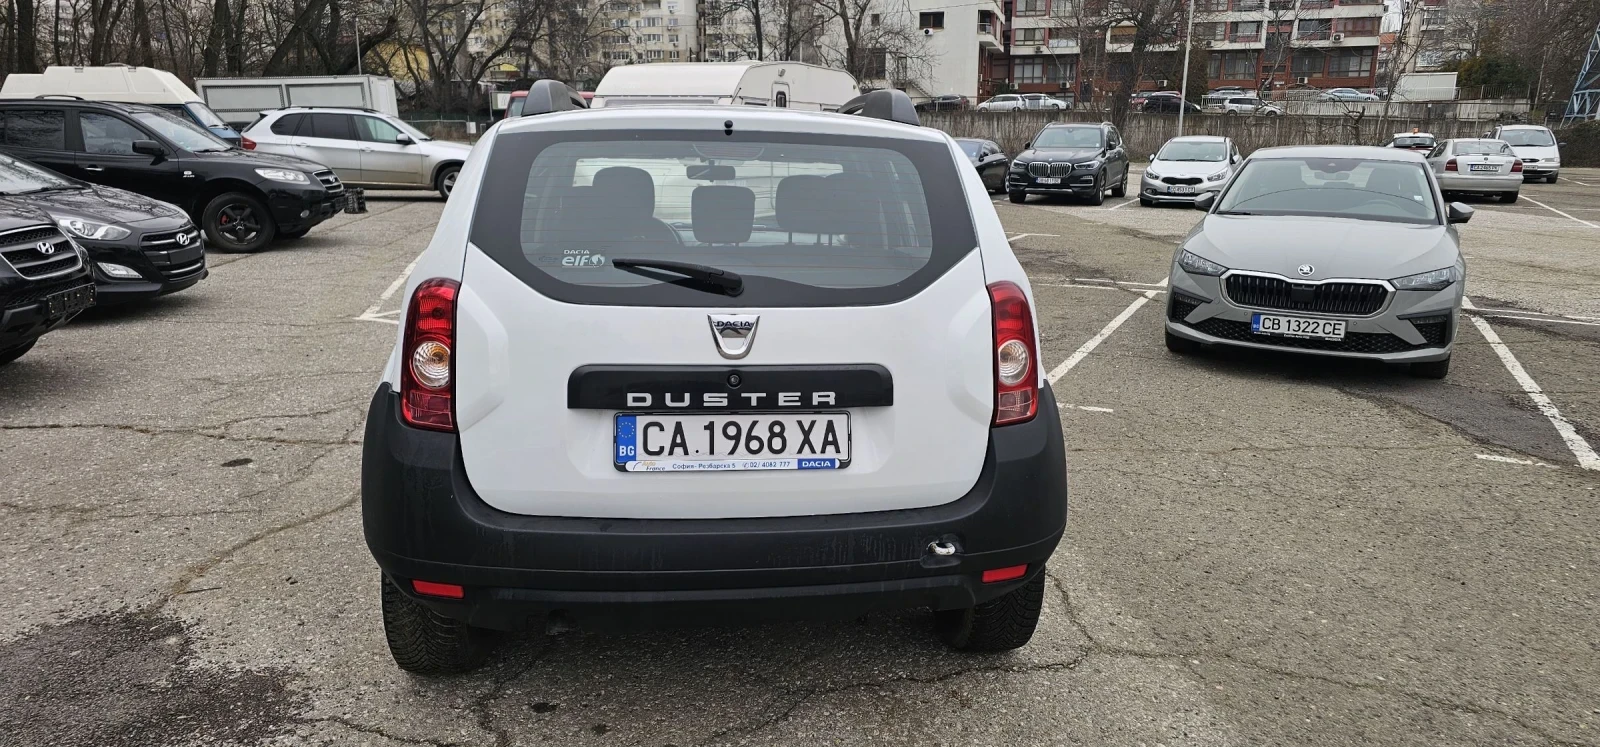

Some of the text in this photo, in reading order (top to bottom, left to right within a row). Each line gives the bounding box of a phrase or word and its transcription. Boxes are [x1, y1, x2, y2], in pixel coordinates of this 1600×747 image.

[561, 255, 590, 266] elf
[1262, 317, 1281, 331] CB
[1286, 319, 1320, 334] 1322
[1322, 322, 1343, 336] CE
[626, 391, 836, 407] DUSTER
[642, 420, 841, 456] CA 1968 XA
[619, 445, 635, 456] BG
